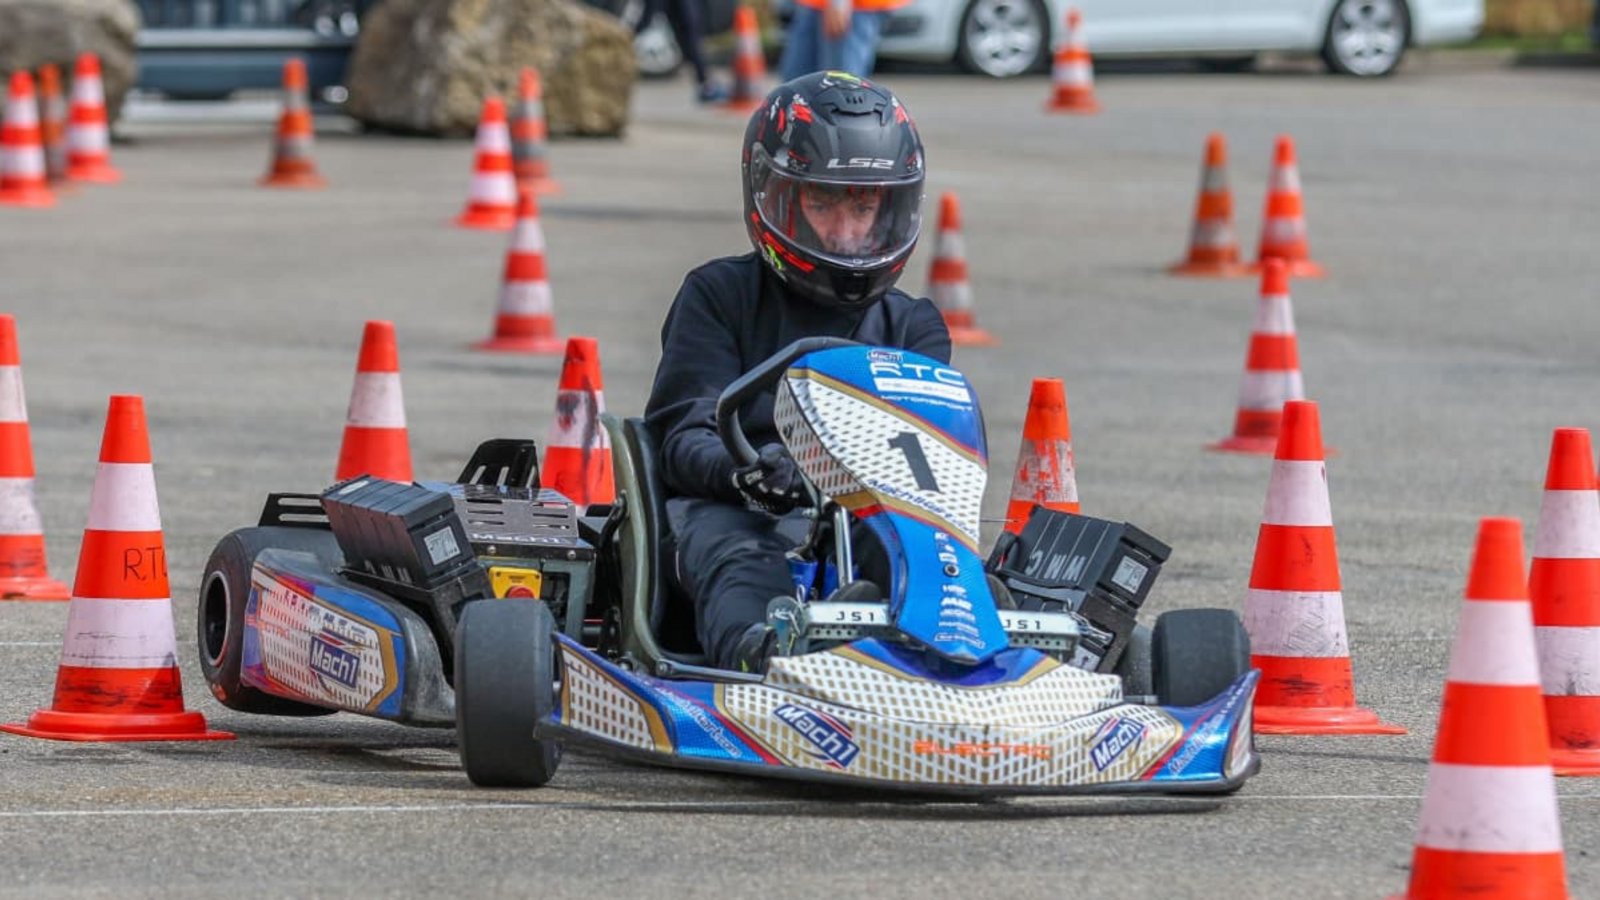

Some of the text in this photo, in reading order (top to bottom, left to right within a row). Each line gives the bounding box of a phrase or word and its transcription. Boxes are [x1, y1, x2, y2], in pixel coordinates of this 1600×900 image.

[827, 157, 894, 170] LS2
[870, 363, 965, 387] RTC
[887, 431, 941, 492] 1
[311, 638, 358, 685] Mach1
[777, 705, 857, 761] Mach1
[1094, 719, 1142, 768] Mach1
